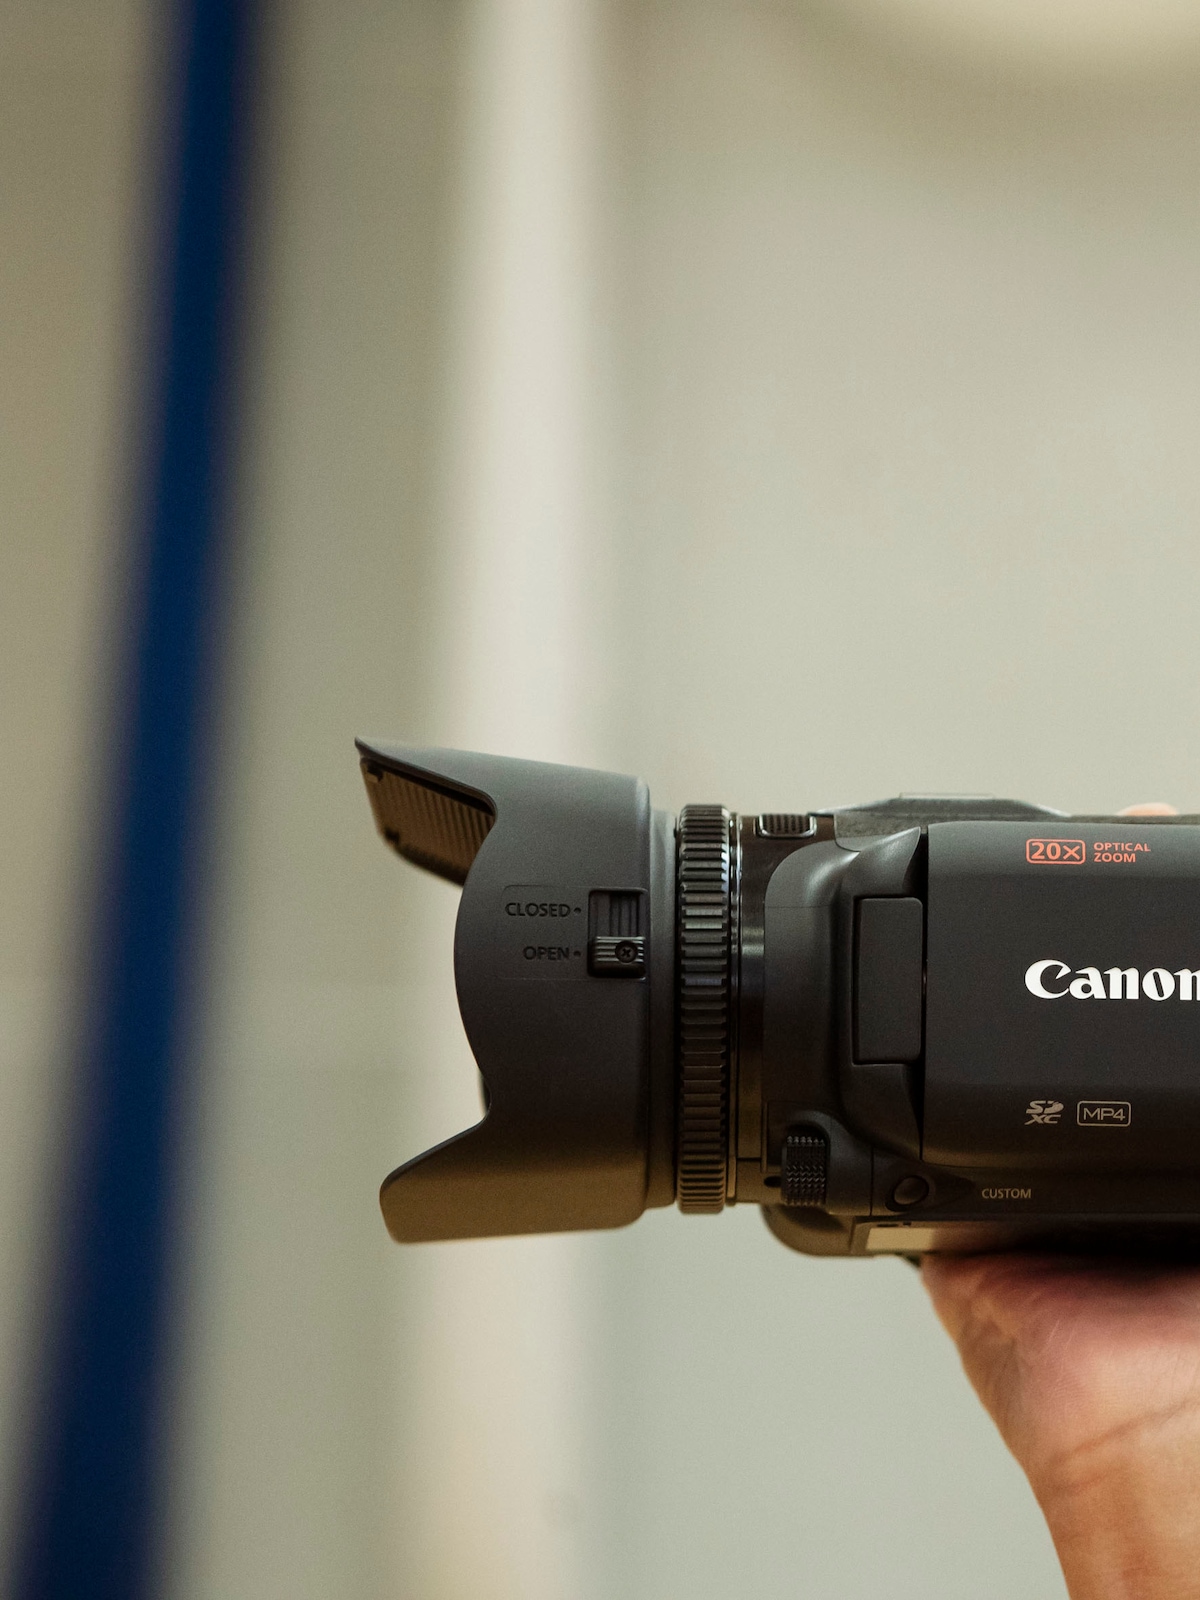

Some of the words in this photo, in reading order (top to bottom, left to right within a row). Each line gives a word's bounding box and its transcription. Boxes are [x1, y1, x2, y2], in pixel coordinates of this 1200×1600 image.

[1093, 842, 1152, 852] OPTICAL
[1093, 852, 1137, 863] ZOOM
[504, 902, 572, 918] CLOSED
[522, 945, 570, 961] OPEN
[1083, 1107, 1126, 1121] MP4
[981, 1187, 1032, 1200] CUSTOM
